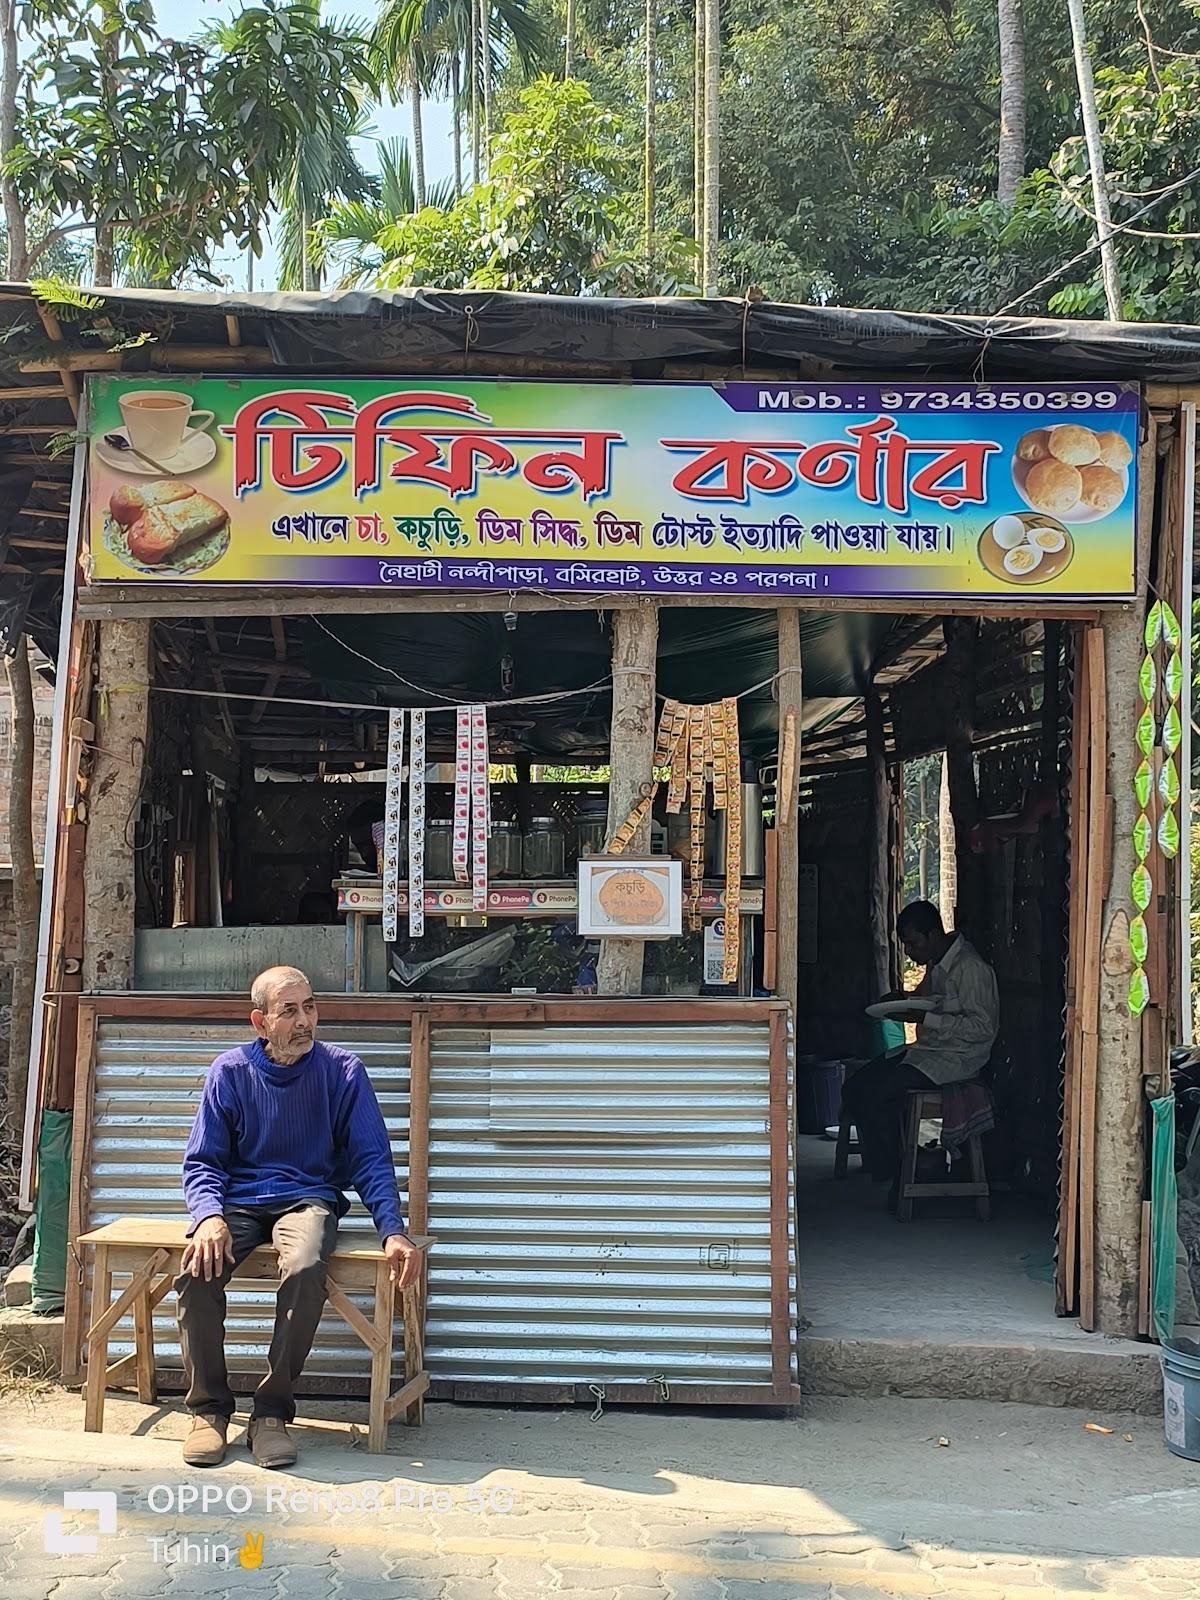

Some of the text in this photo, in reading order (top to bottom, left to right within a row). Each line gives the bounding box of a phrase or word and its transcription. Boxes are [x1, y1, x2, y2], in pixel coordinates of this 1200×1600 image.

[758, 390, 1118, 410] Mob.: 9734350399
[219, 389, 1003, 512] টিফিন কর্ণার
[272, 511, 350, 542] এখানে
[355, 512, 388, 544] চা,
[393, 507, 470, 551] কচুড়ি,
[475, 508, 523, 545] ডিম
[529, 508, 588, 549] সিদ্ধ,
[593, 510, 643, 547] ডিম
[652, 512, 716, 549] টোস্ট
[719, 513, 804, 553] ইত্যাদি
[811, 519, 888, 551] পাওয়া
[379, 559, 443, 583] নৈহাটী
[447, 561, 549, 584] নন্দীপাড়া,
[554, 562, 646, 586] বসিরহাট,
[652, 566, 704, 586] উত্তর
[709, 571, 738, 585] ২৪
[501, 895, 530, 903] PhonePe
[549, 895, 576, 903] PhonePe
